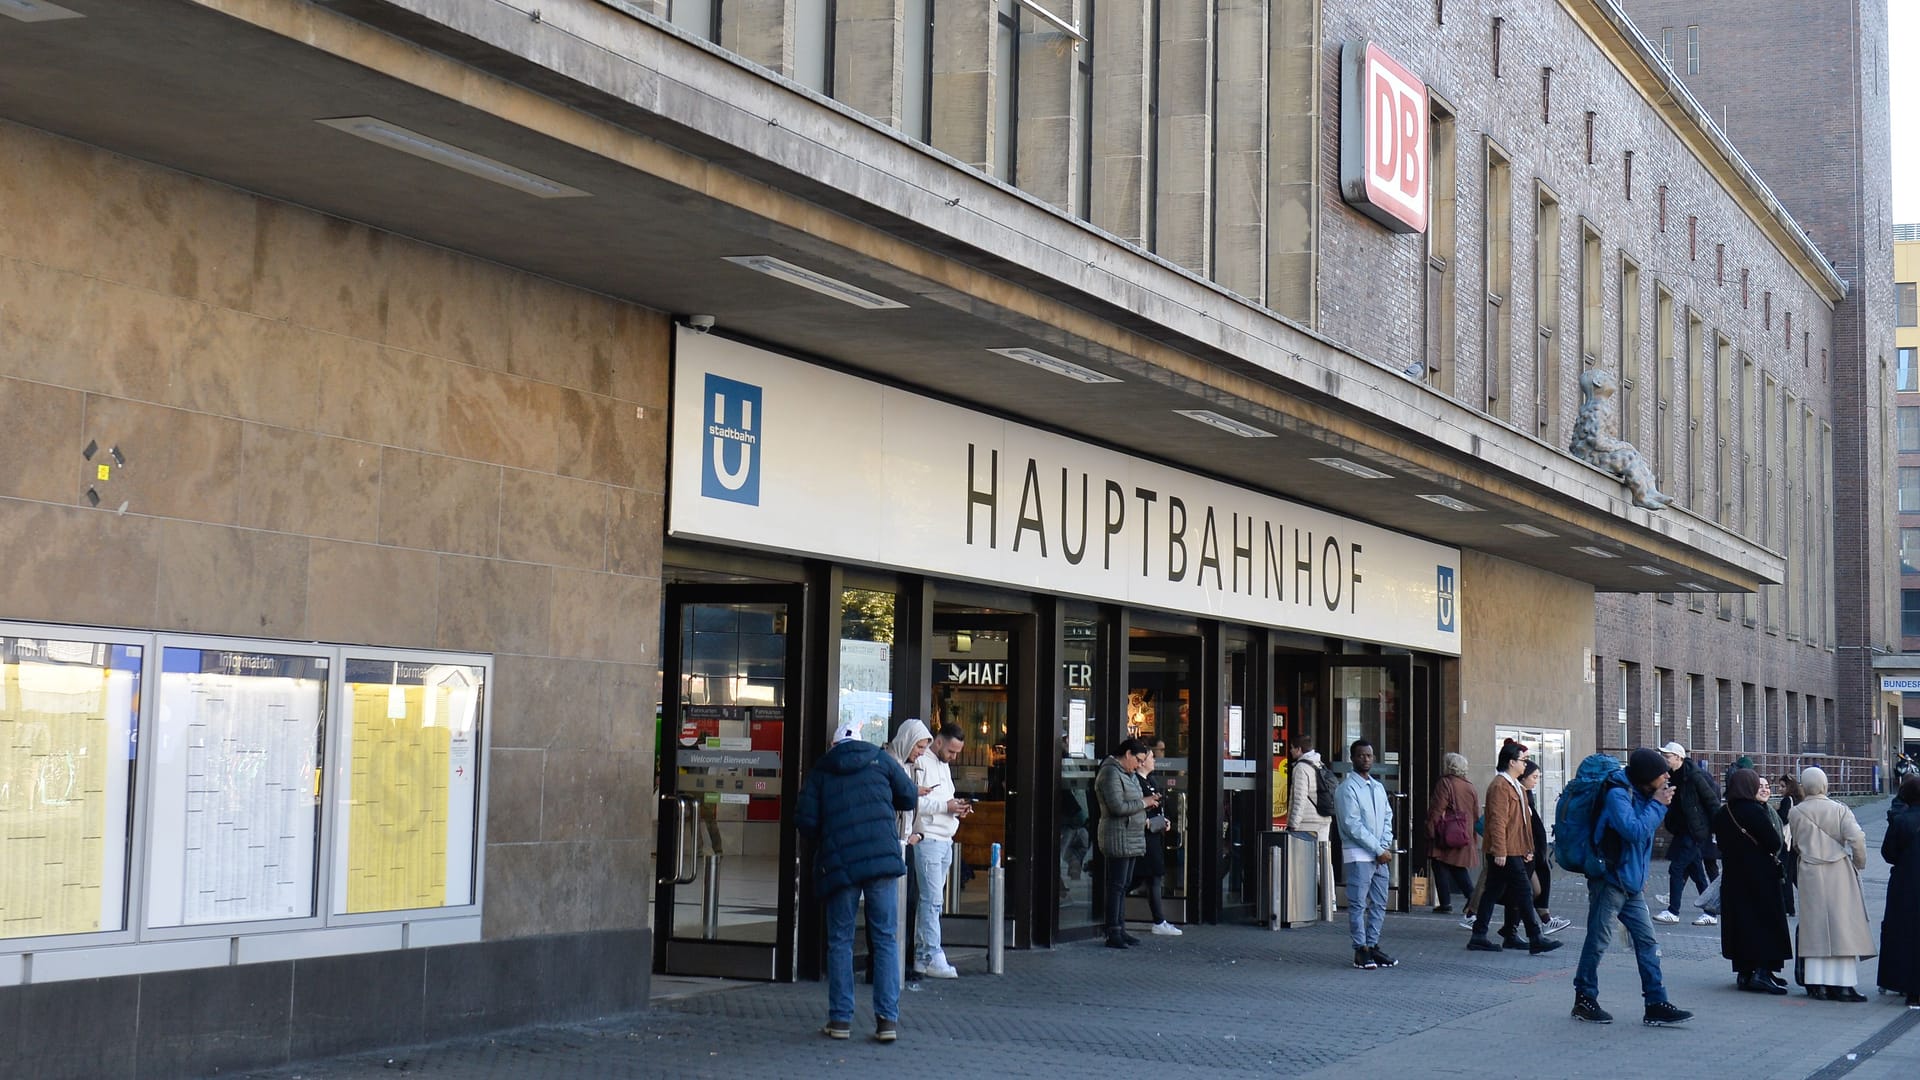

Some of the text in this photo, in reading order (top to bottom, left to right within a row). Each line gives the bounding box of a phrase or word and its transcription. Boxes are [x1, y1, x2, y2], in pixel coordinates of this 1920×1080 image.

[1375, 72, 1420, 198] DB
[709, 425, 756, 444] stadtbahn
[713, 392, 752, 490] U
[966, 443, 1362, 614] HAUPTBAHNHOF
[219, 652, 275, 670] Information
[968, 662, 1009, 685] HAF
[691, 754, 761, 765] Welcome! Bienvenue!
